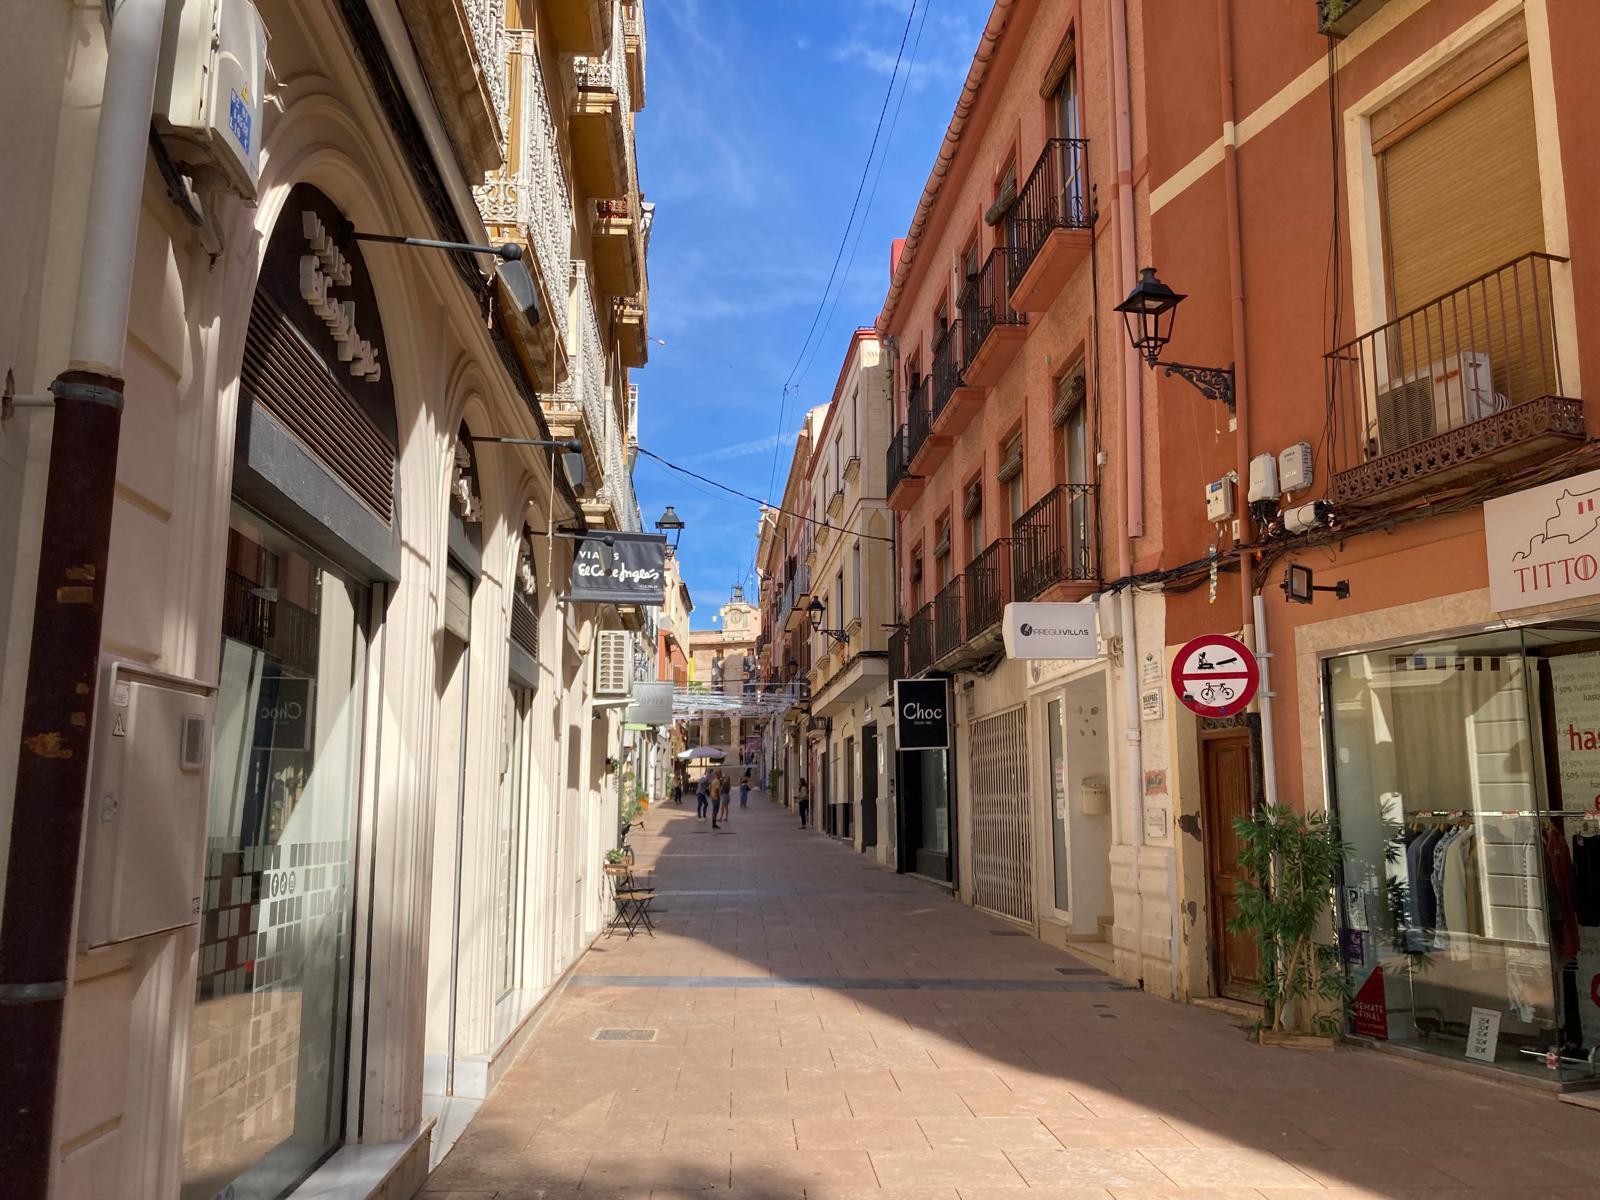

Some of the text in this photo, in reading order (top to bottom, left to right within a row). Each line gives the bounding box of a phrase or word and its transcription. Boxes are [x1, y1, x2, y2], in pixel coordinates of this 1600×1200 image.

[579, 550, 620, 561] VIAS
[591, 564, 619, 578] Coe
[619, 562, 660, 583] Inglés
[903, 702, 944, 720] Choc
